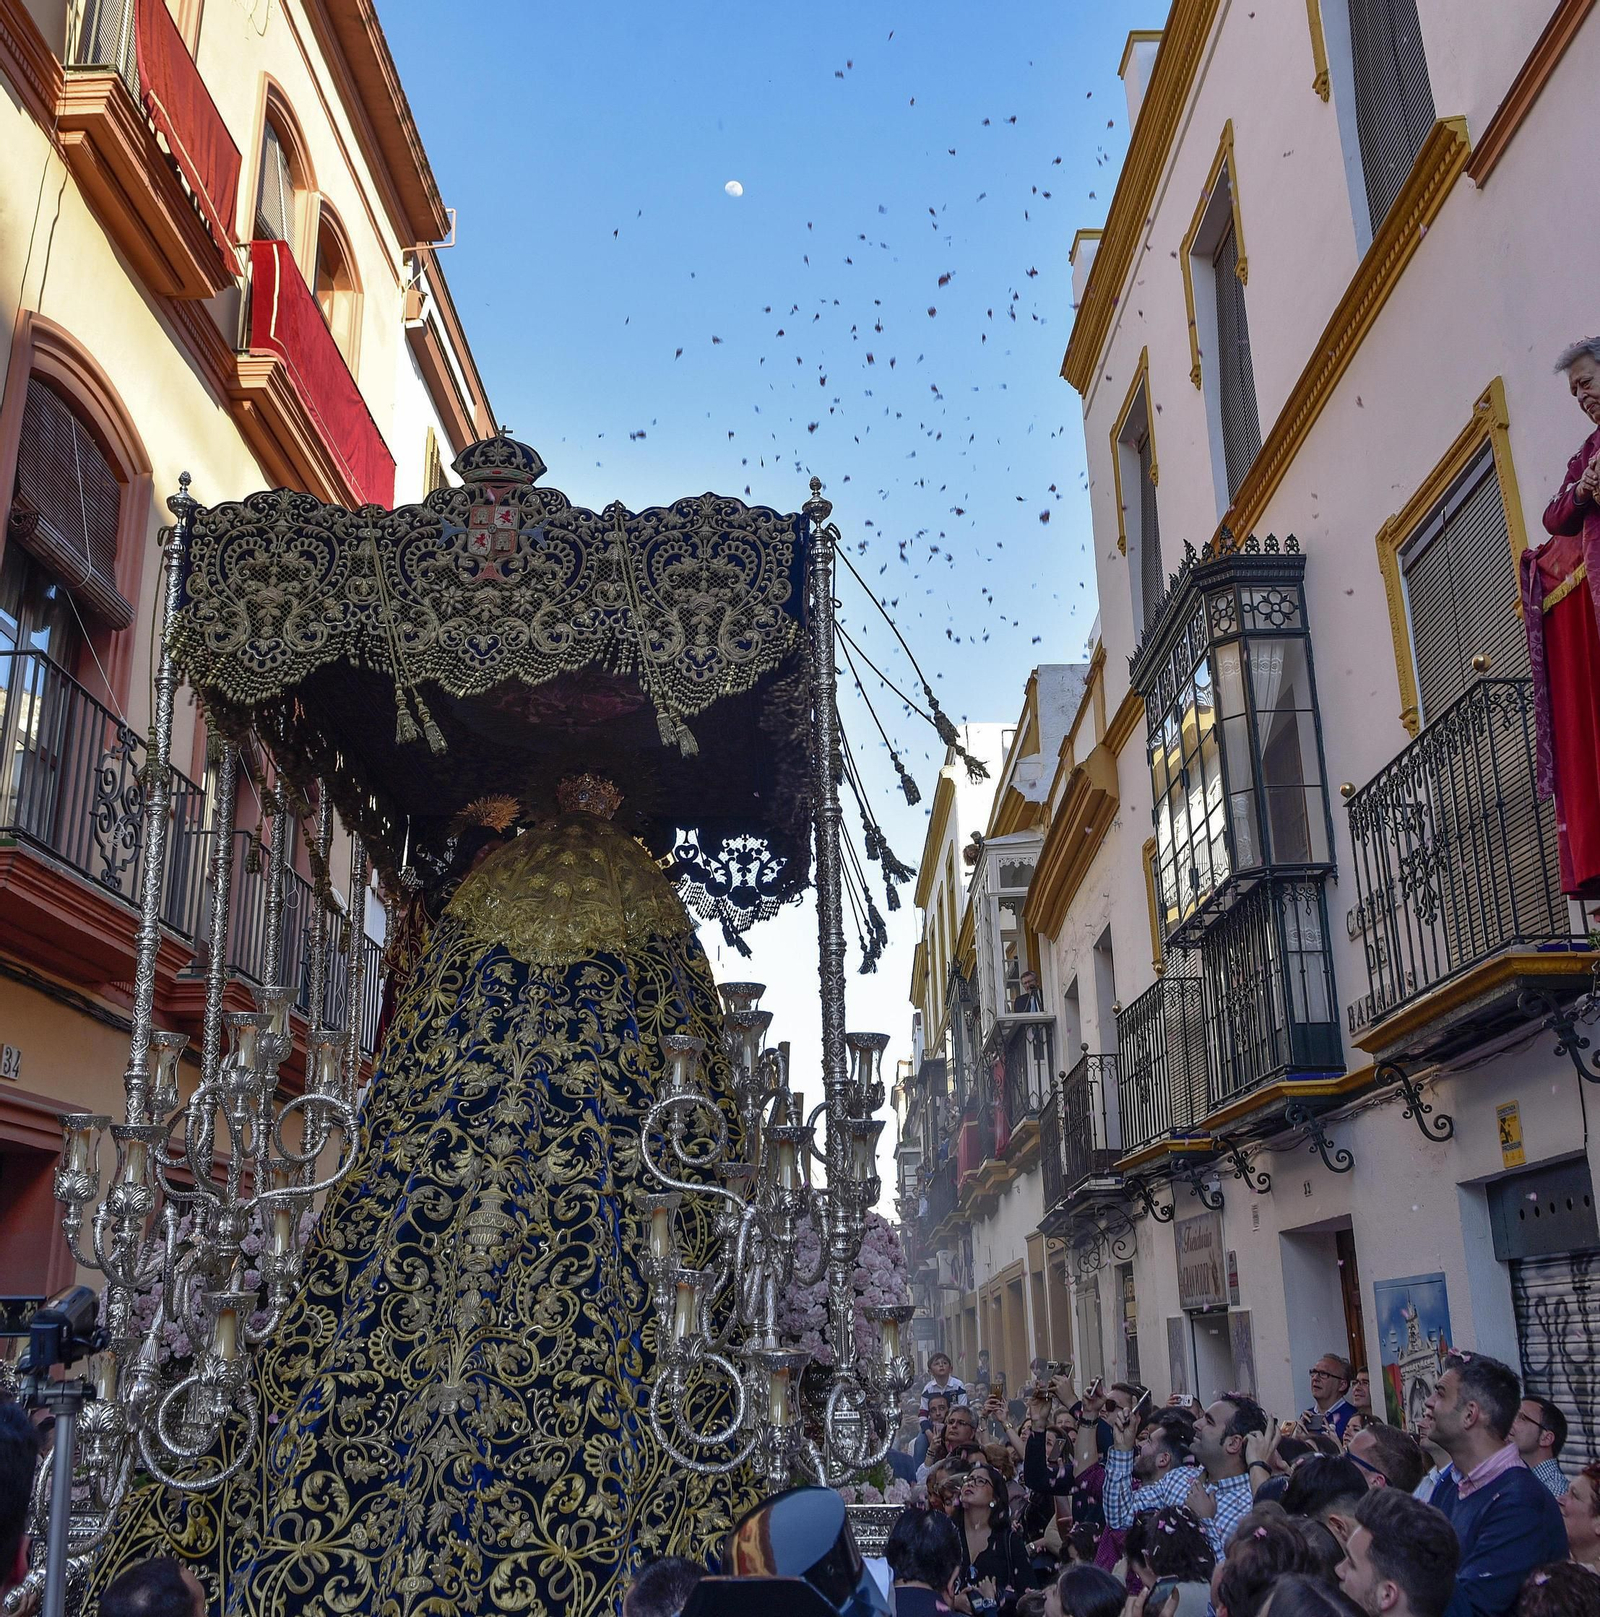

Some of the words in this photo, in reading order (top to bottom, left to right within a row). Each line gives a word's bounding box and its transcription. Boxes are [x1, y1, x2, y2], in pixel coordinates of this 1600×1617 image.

[1367, 936, 1388, 969] DE
[1347, 970, 1413, 1032] BARAJS
[4, 1046, 22, 1078] 34
[1303, 1182, 1311, 1195] 11
